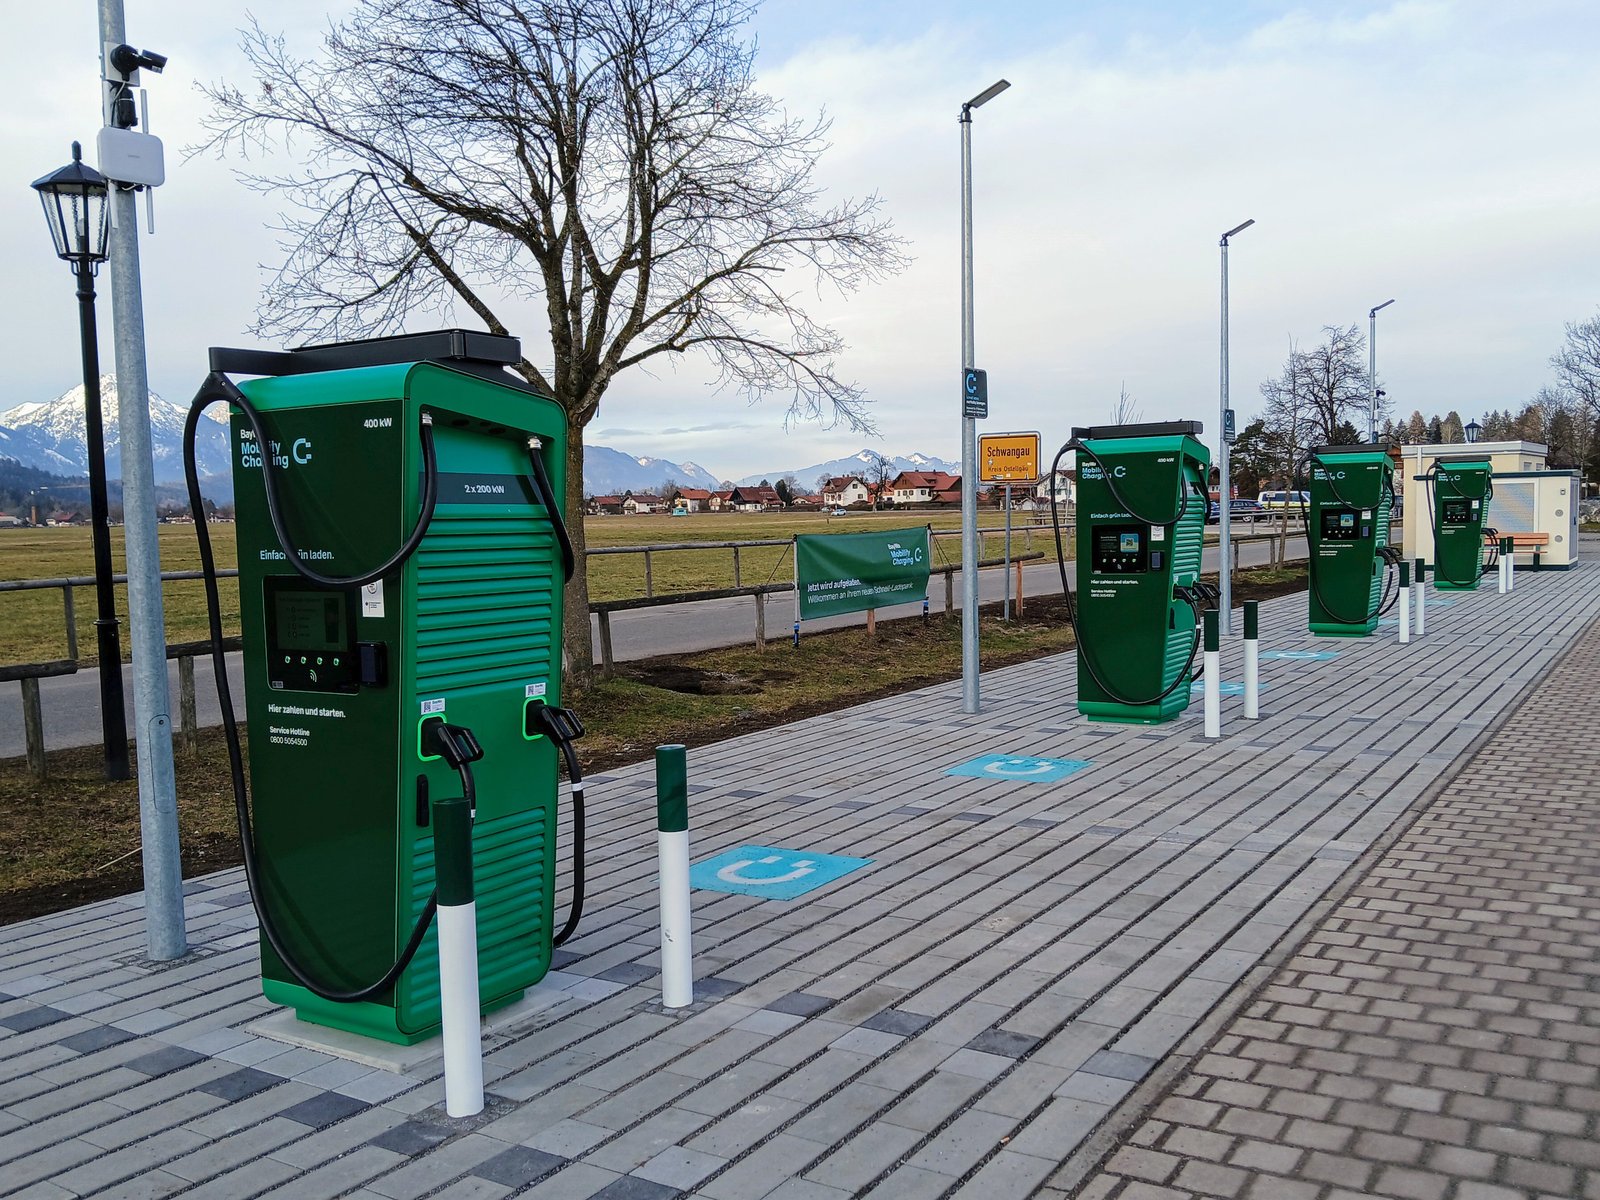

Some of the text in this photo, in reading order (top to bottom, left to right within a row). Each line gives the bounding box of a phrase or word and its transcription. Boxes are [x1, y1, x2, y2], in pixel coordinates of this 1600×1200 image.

[364, 418, 392, 428] 400 kW
[240, 429, 256, 440] Bay
[241, 440, 281, 454] Mobty
[987, 446, 1030, 458] Schwangau
[242, 454, 289, 469] Chaing
[464, 485, 470, 493] 2
[476, 485, 491, 493] 200
[492, 485, 504, 493] kW
[310, 549, 335, 559] laden.
[890, 549, 910, 558] Mobility
[892, 557, 913, 566] Charging
[808, 583, 819, 592] Jetzt
[820, 581, 833, 590] wird
[268, 704, 346, 718] Hier zahlen und starten.
[270, 726, 310, 736] Service Hotline
[270, 736, 283, 744] 0800
